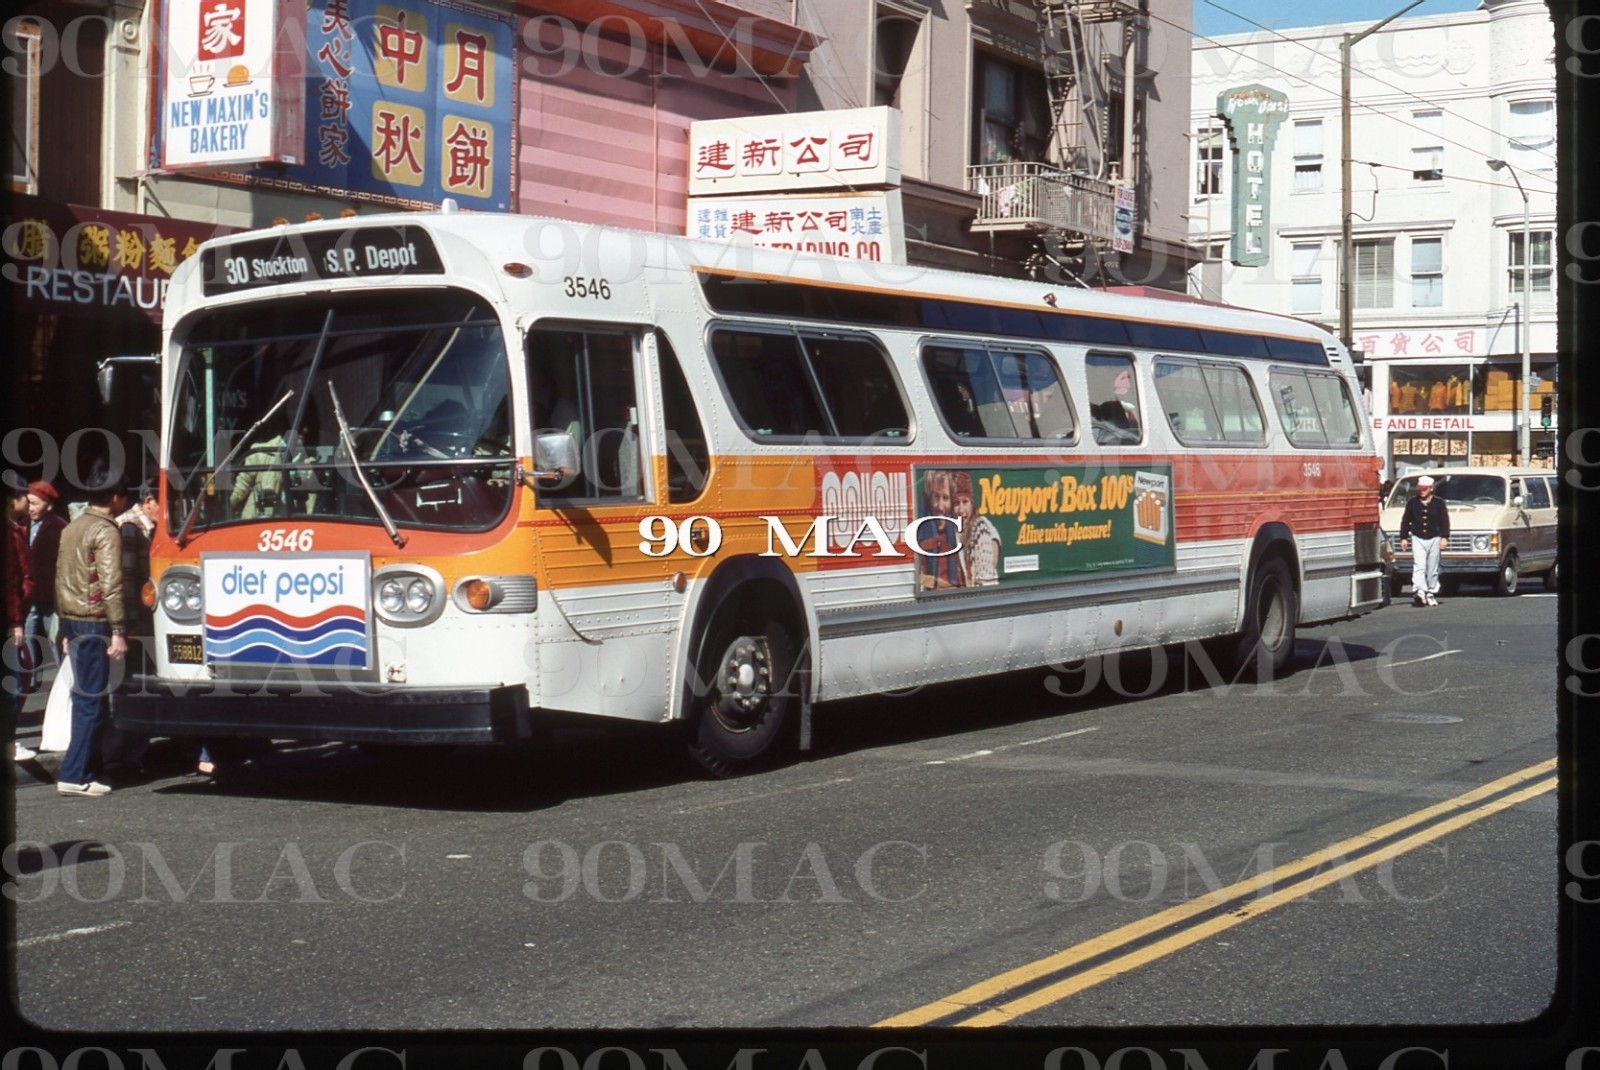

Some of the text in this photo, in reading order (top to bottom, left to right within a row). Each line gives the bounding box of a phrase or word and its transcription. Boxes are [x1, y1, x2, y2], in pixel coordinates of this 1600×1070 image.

[201, 4, 242, 54] 家
[171, 89, 268, 128] NEW MAXIM'S
[190, 123, 249, 154] BAKERY
[697, 132, 873, 173] 建新公司
[1246, 123, 1264, 254] HOTEL
[730, 209, 847, 235] 建新公司
[225, 257, 247, 284] 30
[252, 255, 308, 278] Stockton
[366, 243, 417, 270] Depot
[564, 276, 611, 300] 3546
[1359, 330, 1476, 354] 百貨公司
[1387, 418, 1417, 429] AND
[1422, 418, 1474, 429] RETAIL
[1138, 475, 1165, 488] Newport
[1303, 462, 1321, 477] 3546
[978, 474, 1134, 521] Newport Box 100's
[257, 528, 314, 552] 3546
[1016, 520, 1112, 546] Alive with pleasure!
[222, 565, 344, 603] diet pepsi
